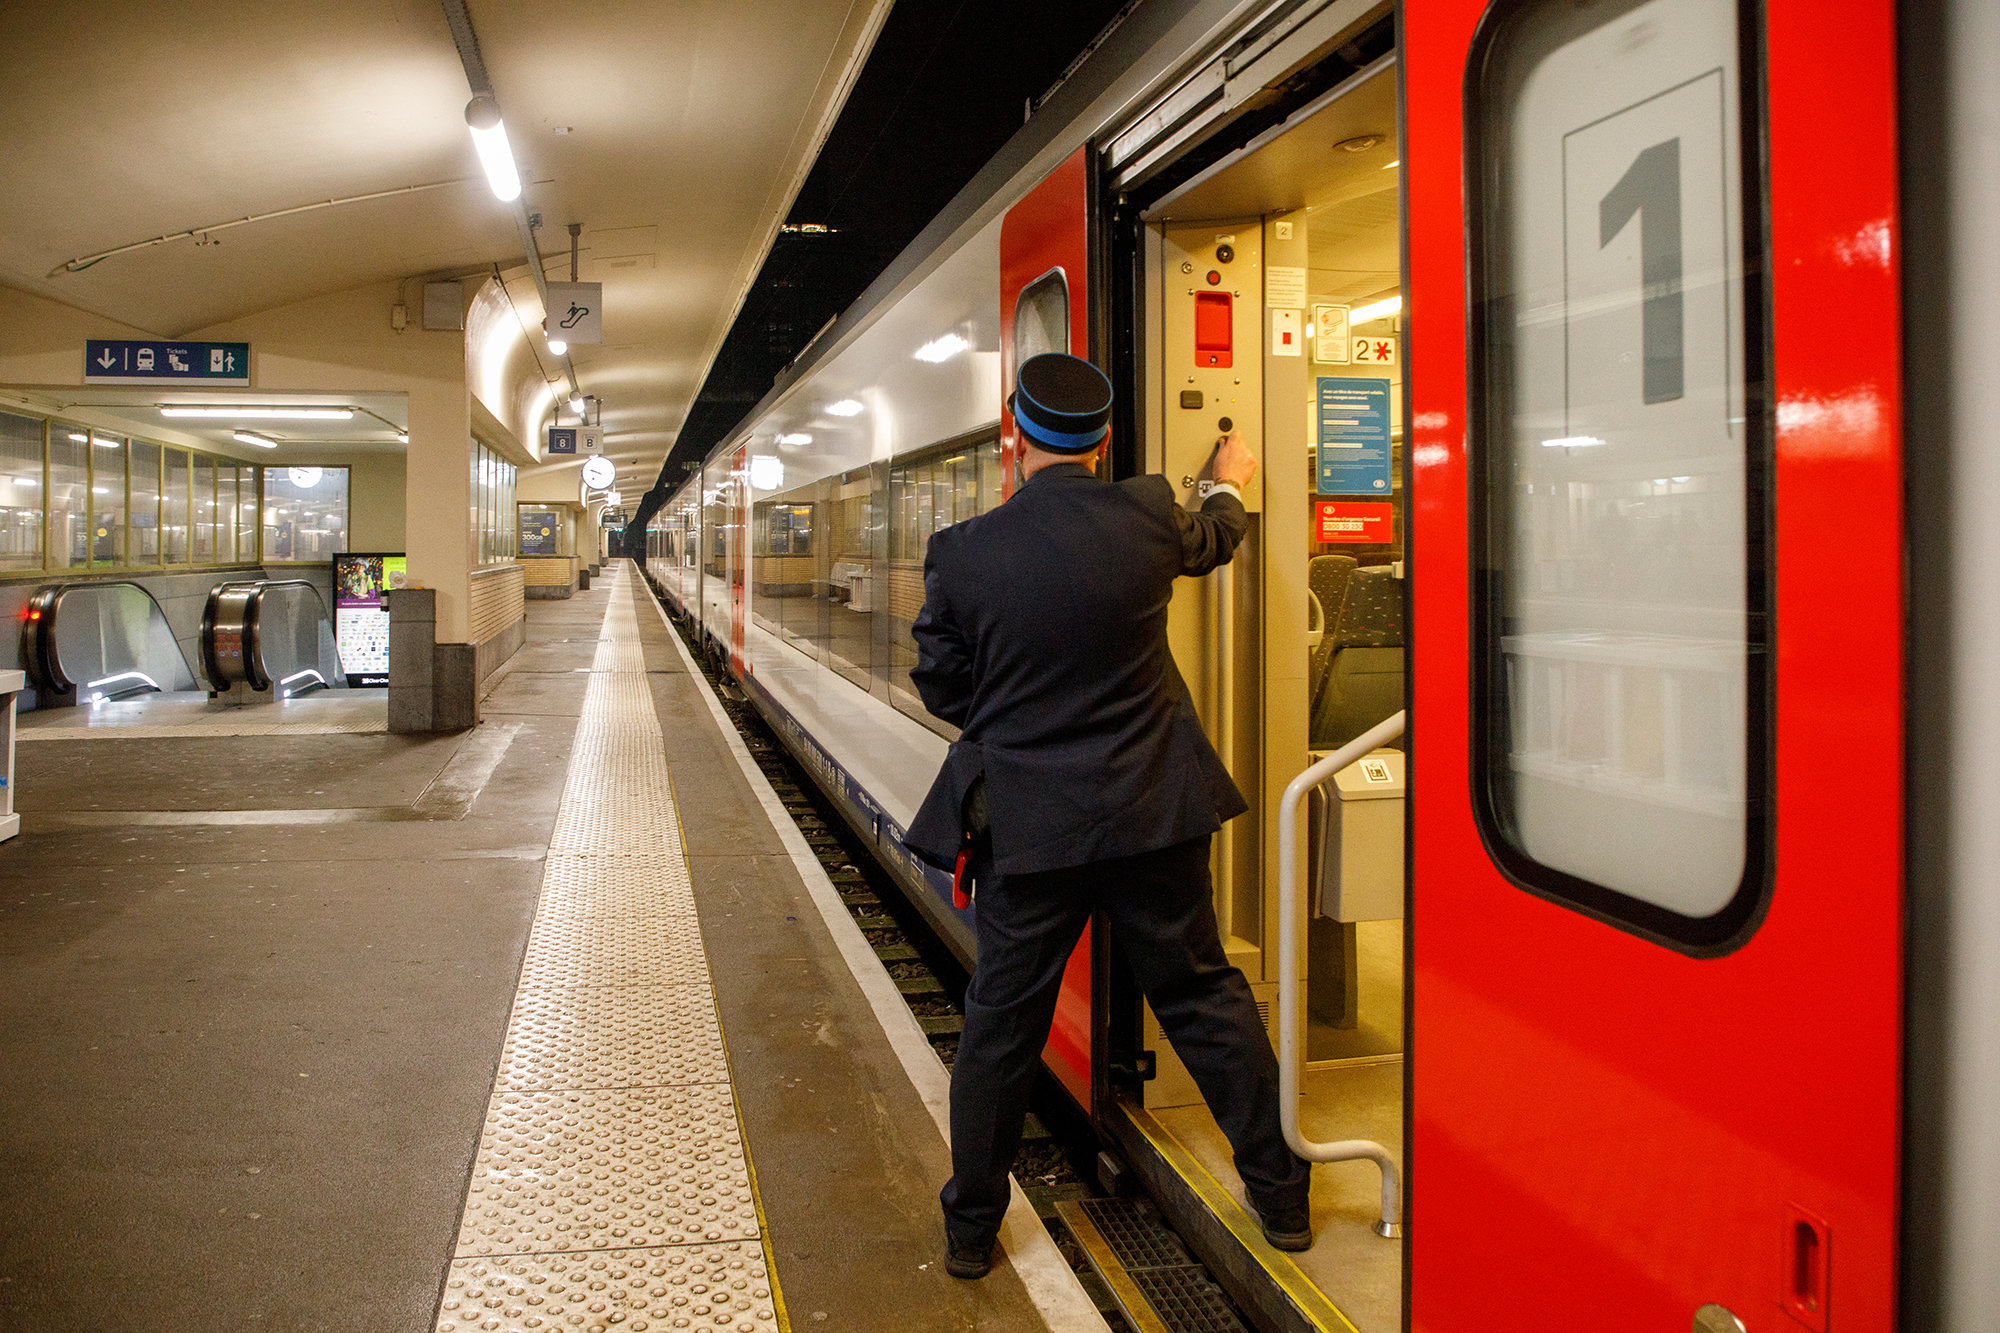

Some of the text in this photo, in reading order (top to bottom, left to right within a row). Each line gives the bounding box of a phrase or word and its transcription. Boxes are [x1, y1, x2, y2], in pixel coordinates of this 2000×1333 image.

[1280, 226, 1288, 236] 2
[1599, 137, 1684, 405] 1
[1356, 339, 1369, 361] 2
[559, 438, 566, 448] 8
[586, 438, 593, 447] B
